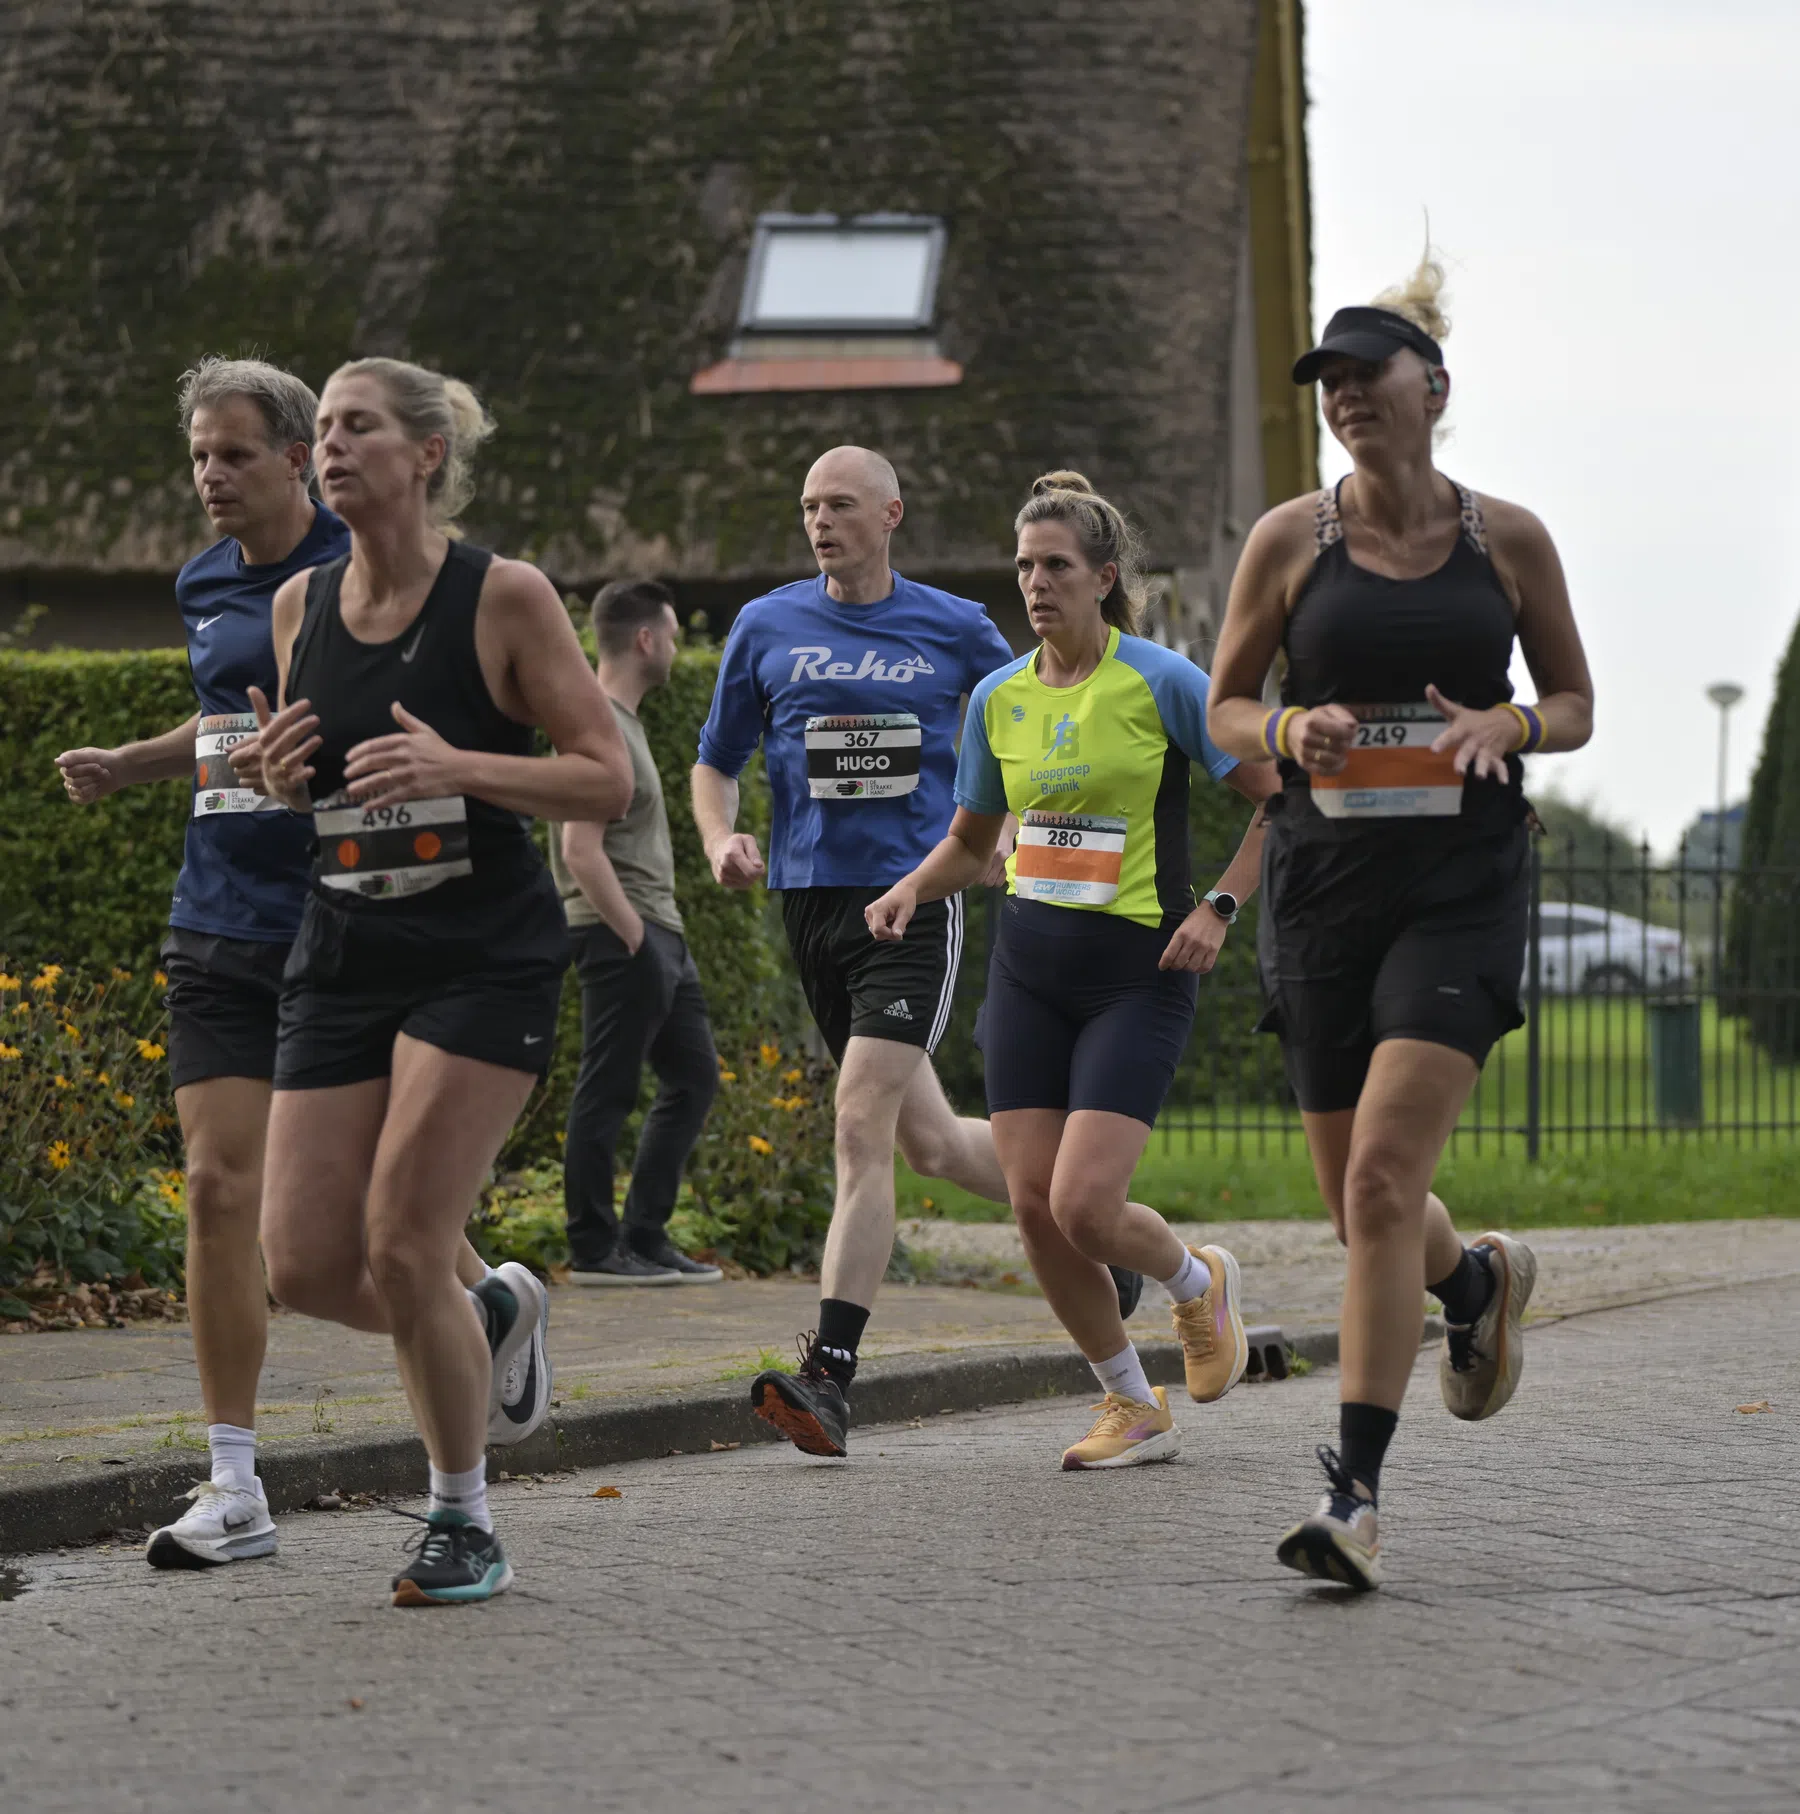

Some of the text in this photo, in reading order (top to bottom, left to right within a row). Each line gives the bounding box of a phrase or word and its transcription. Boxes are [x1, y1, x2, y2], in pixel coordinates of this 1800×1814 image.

[788, 646, 935, 683] Reko
[215, 735, 245, 752] 49
[844, 732, 880, 747] 367
[1357, 725, 1407, 746] 249
[836, 755, 890, 771] HUGO
[1030, 764, 1090, 782] Loopgroep
[1041, 779, 1080, 796] Bunnik
[362, 806, 412, 827] 496
[1047, 829, 1083, 848] 280
[1055, 888, 1081, 896] WORLD
[1056, 882, 1092, 891] RUNNERS
[883, 1008, 913, 1020] adidas
